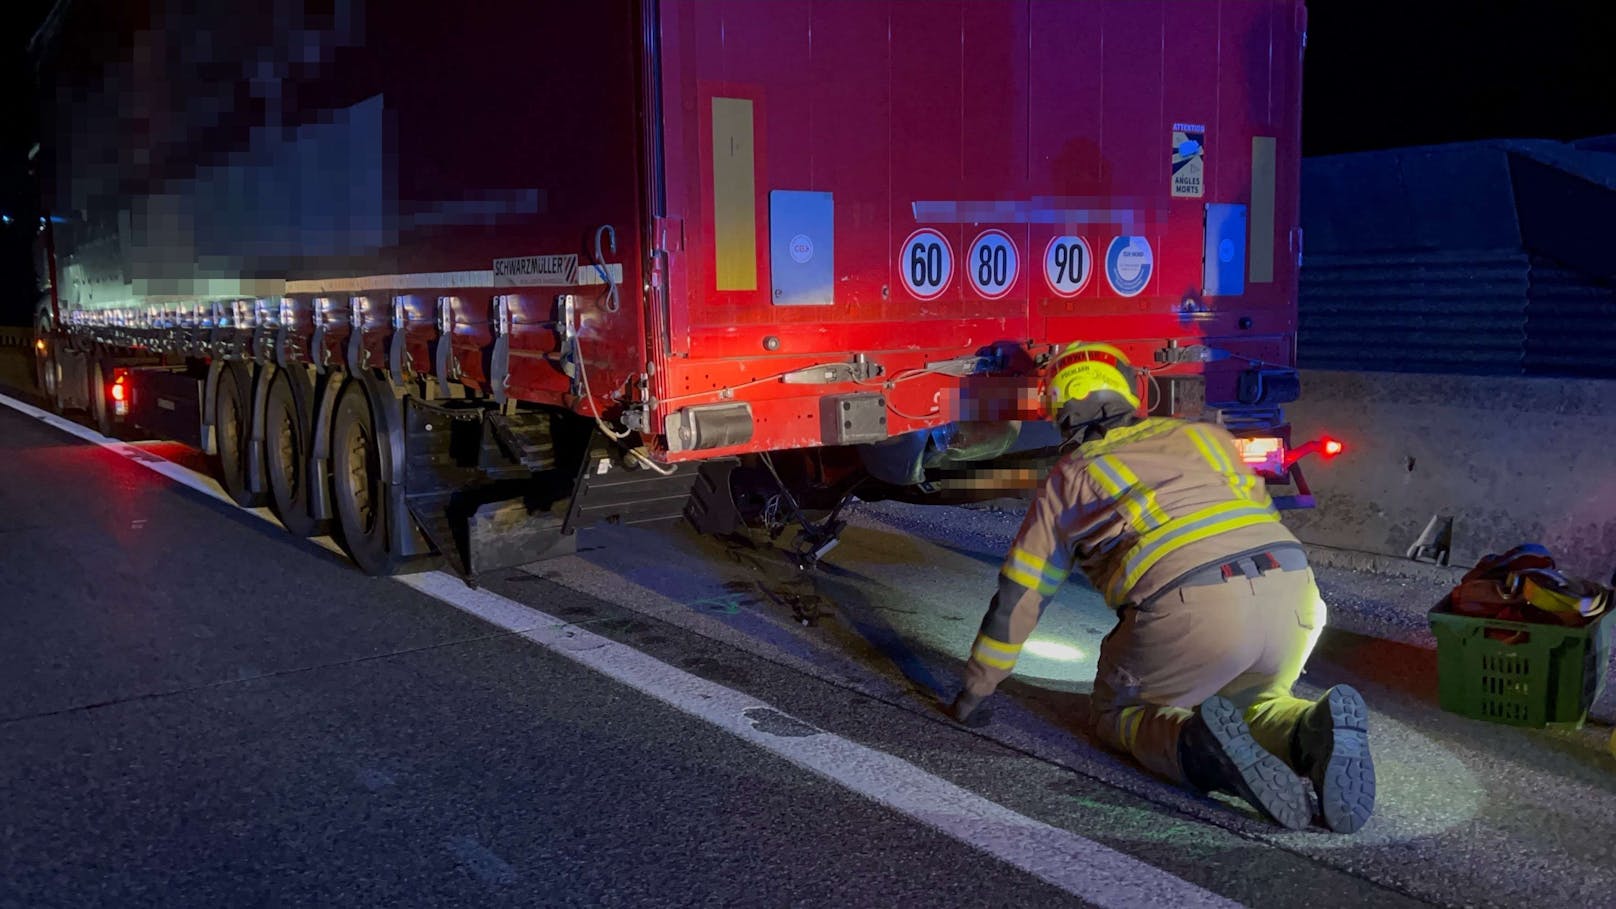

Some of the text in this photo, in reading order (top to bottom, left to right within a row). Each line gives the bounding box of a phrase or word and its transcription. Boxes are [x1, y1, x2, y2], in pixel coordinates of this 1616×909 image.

[1176, 185, 1199, 193] MORTS
[495, 256, 563, 276] SCHWARZMÜLLER
[911, 242, 942, 287] 60
[978, 244, 1007, 286] 80
[1054, 243, 1083, 284] 90
